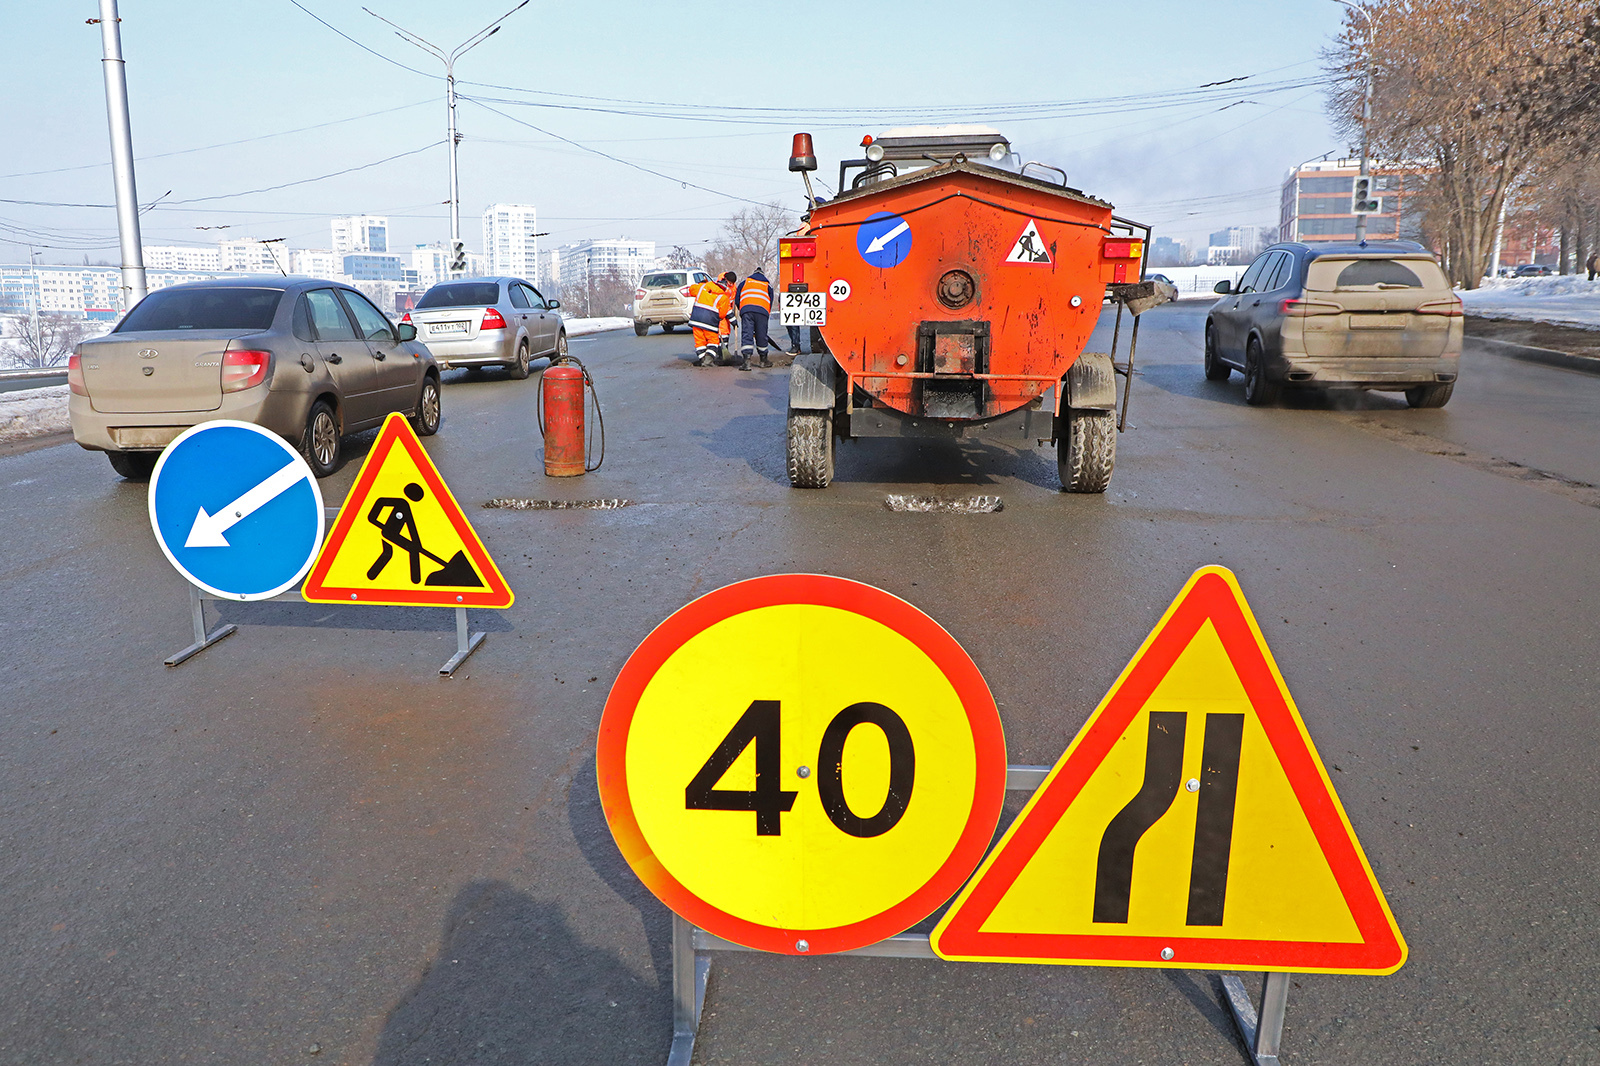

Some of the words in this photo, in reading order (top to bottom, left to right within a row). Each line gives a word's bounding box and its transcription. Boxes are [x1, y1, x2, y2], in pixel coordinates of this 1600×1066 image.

[833, 286, 847, 295] 20
[786, 294, 820, 307] 2948
[809, 310, 822, 320] 02
[685, 699, 916, 838] 40
